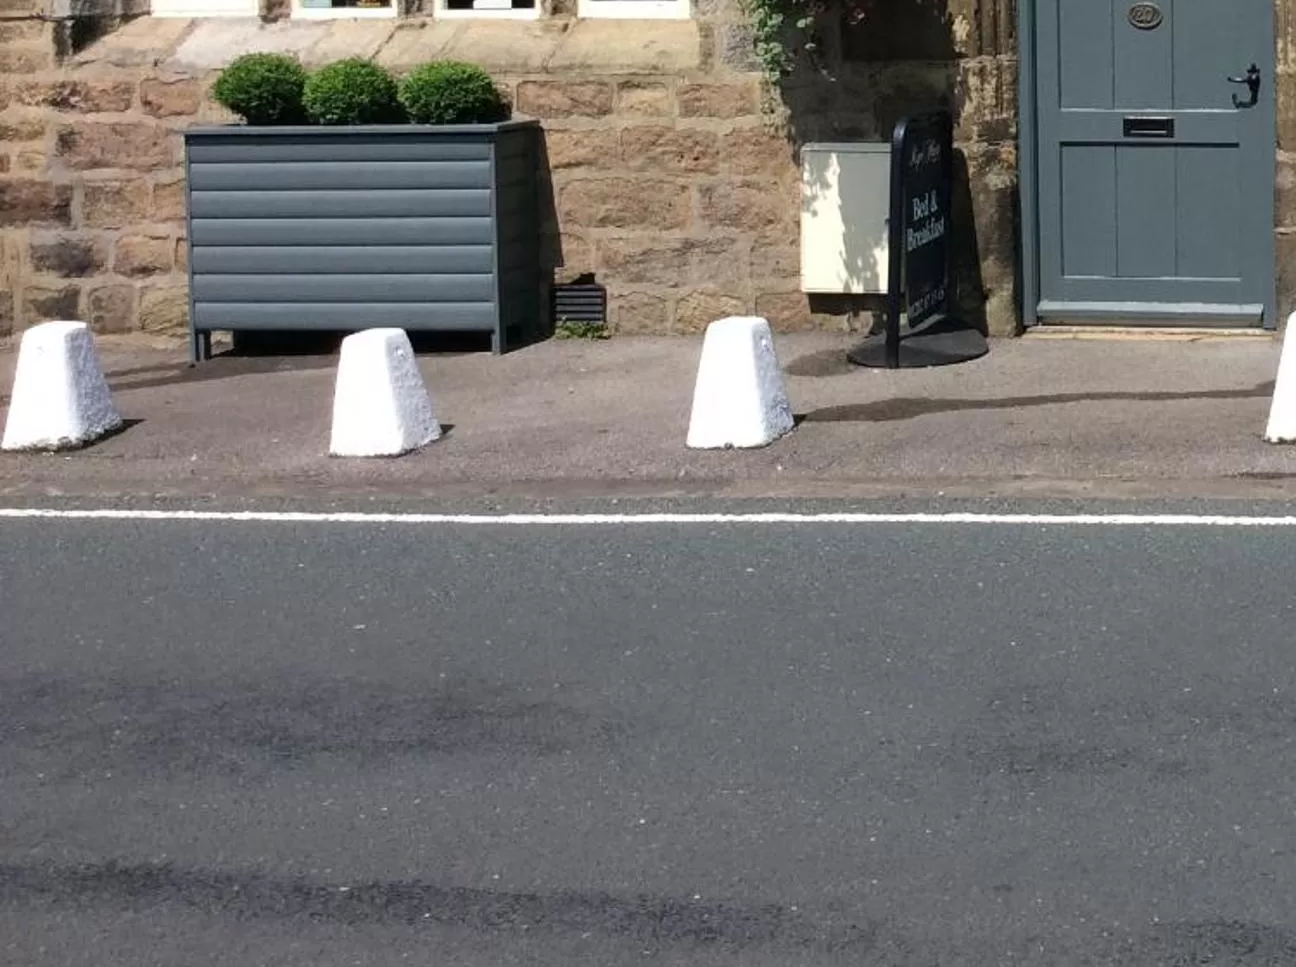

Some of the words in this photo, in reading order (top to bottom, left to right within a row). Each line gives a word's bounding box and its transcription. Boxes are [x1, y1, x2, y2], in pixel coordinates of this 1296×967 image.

[912, 192, 929, 221] Bed
[930, 189, 938, 212] &
[907, 216, 944, 251] Breakfast
